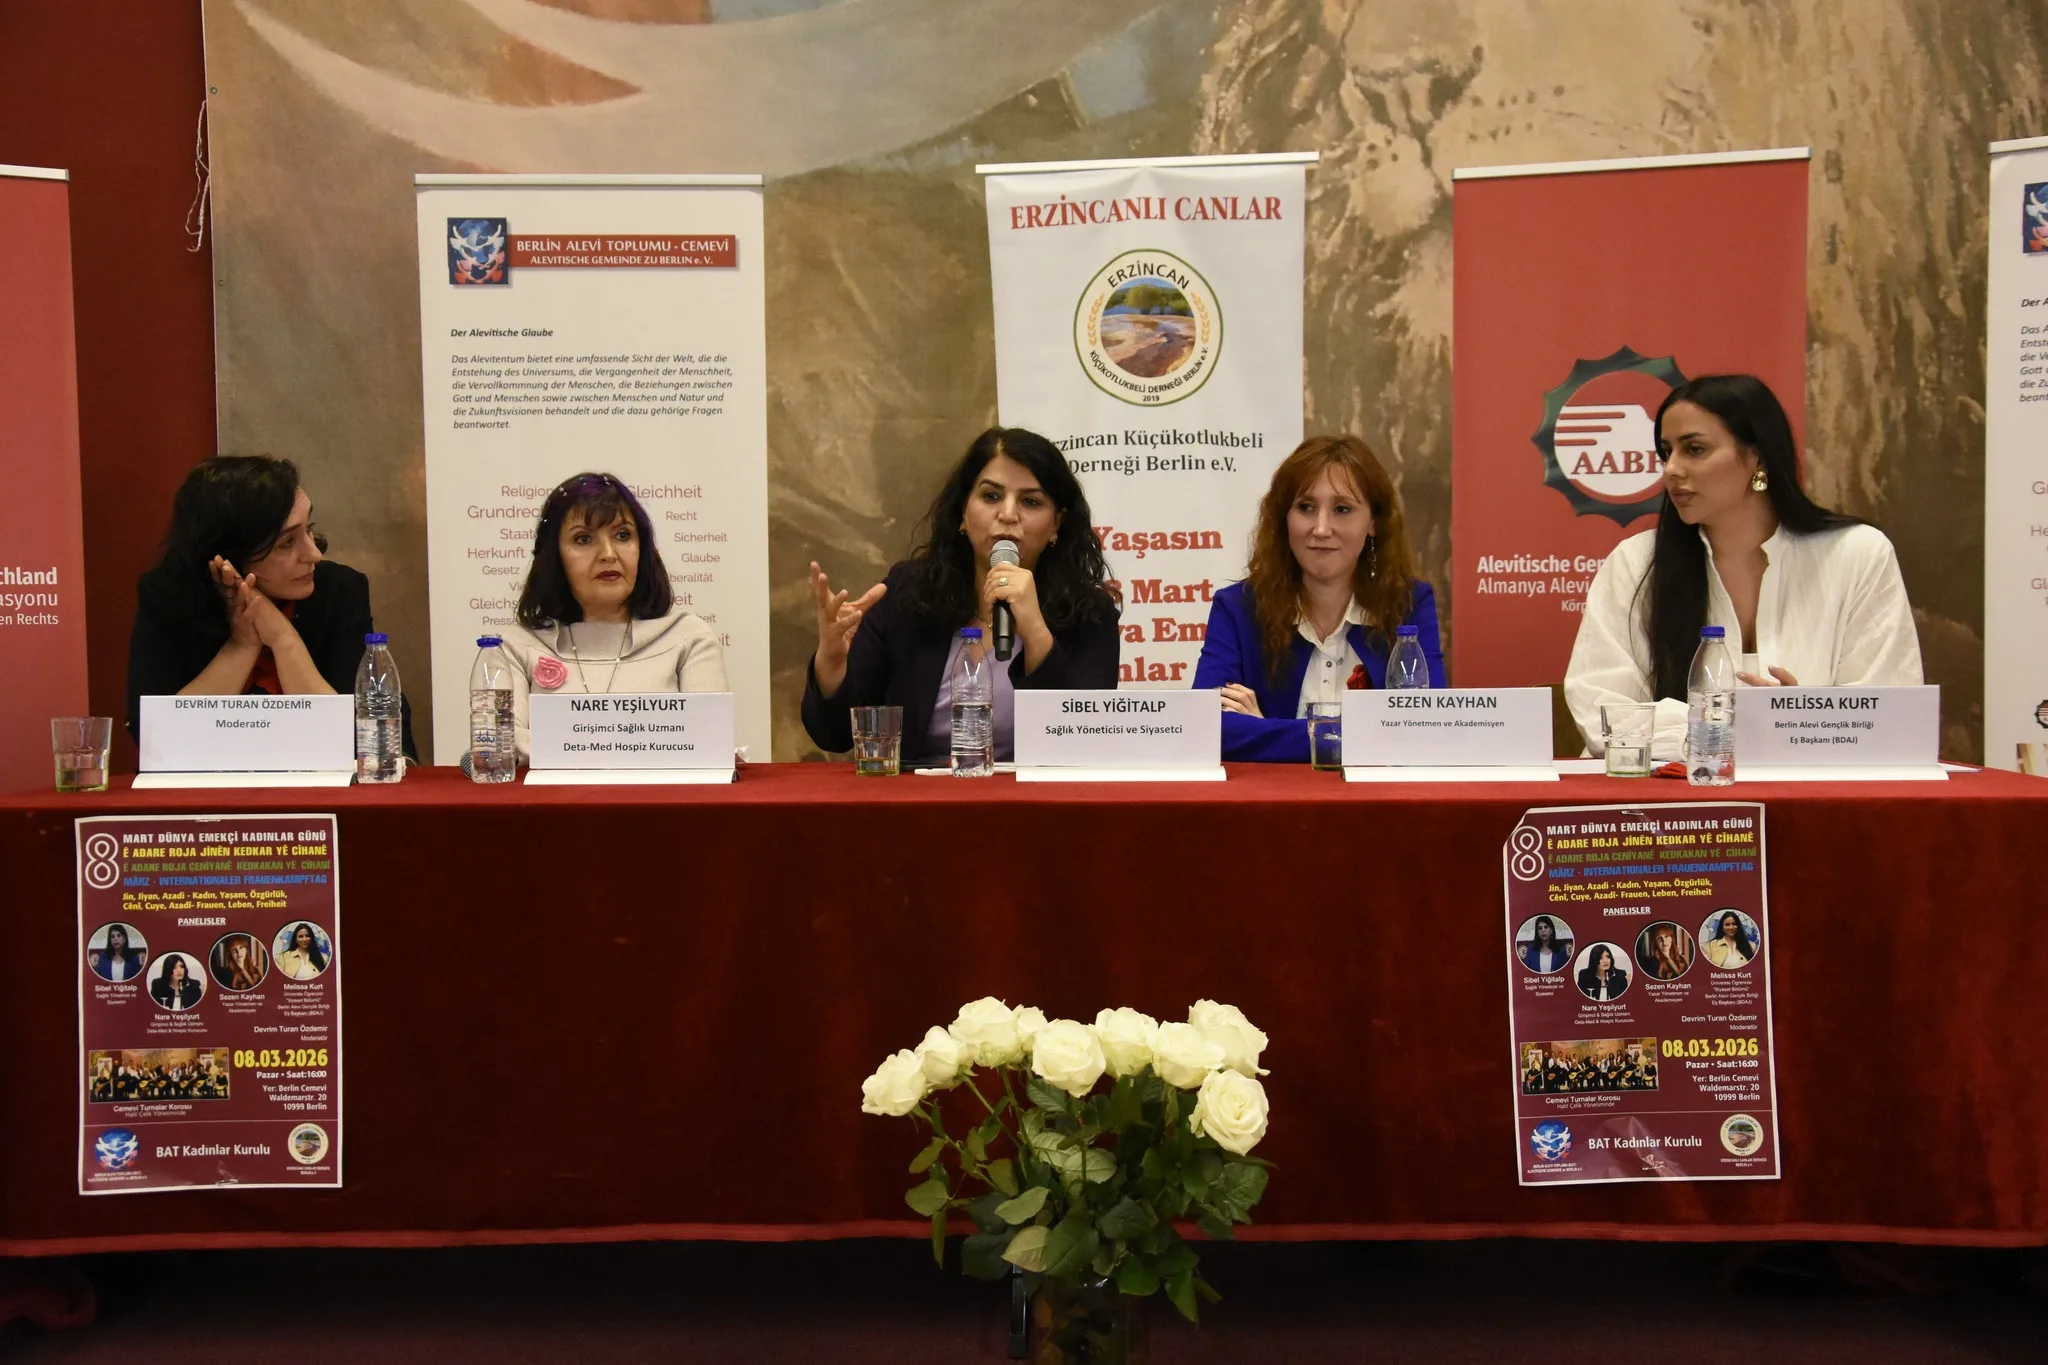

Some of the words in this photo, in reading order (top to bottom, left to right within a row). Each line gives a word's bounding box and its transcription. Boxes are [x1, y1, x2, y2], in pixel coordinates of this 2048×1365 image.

[1010, 194, 1166, 230] ERZİNCANLI
[1174, 196, 1282, 222] CANLAR
[517, 238, 561, 251] BERLİN
[566, 238, 601, 251] ALEVİ
[606, 240, 671, 251] TOPLUMU
[681, 238, 728, 251] CEMEVİ
[530, 256, 590, 264] ALEVITISCHE
[591, 256, 642, 264] GEMEINDE
[644, 256, 658, 264] ZU
[659, 256, 692, 264] BERLIN
[1107, 260, 1190, 291] ERZİNCAN
[2021, 298, 2041, 308] Der
[450, 329, 467, 337] Der
[469, 328, 519, 337] Alevitische
[521, 328, 553, 337] Glaube
[2020, 326, 2040, 335] Das
[451, 355, 468, 363] Das
[470, 354, 525, 363] Alevitentum
[527, 354, 553, 363] bietet
[576, 354, 630, 365] umfassende
[632, 354, 653, 363] Sicht
[655, 354, 670, 363] der
[673, 354, 695, 364] Welt,
[698, 354, 712, 363] die
[712, 354, 727, 363] die
[452, 368, 502, 378] Entstehung
[504, 368, 520, 376] des
[522, 368, 576, 377] Universums,
[578, 368, 593, 376] die
[595, 367, 660, 378] Vergangenheit
[662, 367, 677, 376] der
[679, 367, 732, 376] Menschheit,
[452, 381, 466, 390] die
[468, 380, 549, 391] Vervollkommnung
[550, 380, 566, 389] der
[568, 380, 616, 390] Menschen,
[618, 380, 632, 389] die
[634, 380, 691, 390] Beziehungen
[692, 380, 732, 389] zwischen
[1148, 376, 1183, 393] DERNEĞİ
[453, 420, 511, 429] beantwortet.
[1053, 434, 1118, 451] zincan
[1124, 429, 1264, 451] Küçükotlukbeli
[1068, 455, 1140, 476] Derneği
[1146, 454, 1206, 472] Berlin
[1211, 456, 1236, 472] e.V.
[467, 504, 542, 518] Grundrec
[665, 510, 697, 521] Recht
[674, 532, 728, 542] Sicherheit
[1092, 526, 1223, 559] Yaşasın
[467, 546, 525, 559] Herkunft
[681, 553, 720, 563] Glaube
[1476, 554, 1571, 574] Alevitische
[482, 565, 520, 575] Gesetz
[669, 572, 714, 583] beralität
[1131, 579, 1214, 604] Mart
[1477, 577, 1546, 598] Almanya
[1550, 576, 1590, 594] Alevi
[16, 612, 59, 625] Rechts
[1119, 656, 1188, 682] nlar
[175, 698, 218, 709] DEVRİM
[221, 700, 258, 709] TURAN
[262, 698, 312, 709] ÖZDEMİR
[571, 699, 609, 711] NARE
[613, 696, 686, 714] YEŞİLYURT
[1062, 698, 1099, 713] SİBEL
[1103, 696, 1166, 713] YİĞİTALP
[1388, 696, 1432, 708] SEZEN
[1436, 696, 1497, 708] KAYHAN
[1771, 694, 1834, 710] MELİSSA
[1839, 697, 1879, 710] KURT
[216, 719, 271, 728] Moderatör
[572, 723, 615, 734] Girişimci
[617, 723, 646, 734] Sağlık
[648, 723, 684, 732] Uzmanı
[1454, 720, 1504, 728] Akademisyen
[1820, 721, 1850, 730] Gençlik
[1851, 721, 1874, 730] Birliği
[1045, 724, 1074, 736] Sağlık
[1076, 725, 1123, 734] Yöneticisi
[1140, 724, 1182, 736] Siyasetci
[1790, 736, 1798, 745] Eş
[1800, 736, 1830, 745] Başkanı
[1832, 736, 1858, 745] (BDAJ)
[564, 742, 612, 751] Deta-Med
[615, 742, 646, 753] Hospiz
[649, 742, 694, 751] Kurucusu
[1556, 838, 1589, 849] ADARE
[1592, 837, 1619, 848] ROJA
[1622, 834, 1653, 846] JİNÊN
[1656, 835, 1696, 845] KEDKAR
[1716, 831, 1754, 843] CÎHANÊ
[1511, 826, 1545, 882] 8
[1546, 824, 1576, 835] MART
[1581, 822, 1616, 834] DÜNYA
[1620, 820, 1660, 834] EMEKÇİ
[1664, 820, 1718, 830] KADINLAR
[1723, 817, 1752, 829] GÜNÜ
[84, 832, 120, 889] 8
[123, 834, 154, 844] MART
[158, 832, 195, 843] DÜNYA
[198, 830, 238, 844] EMEKÇİ
[242, 832, 294, 842] KADINLAR
[298, 830, 326, 841] GÜNÜ
[178, 917, 226, 925] PANELISLER
[1662, 1038, 1758, 1058] 08.03.2026
[234, 1048, 328, 1068] 08.03.2026
[1686, 1061, 1709, 1069] Pazar
[1716, 1060, 1758, 1068] Saat:16:00
[256, 1071, 279, 1079] Pazar
[286, 1070, 327, 1078] Saat:16:00
[278, 1084, 300, 1092] Berlin
[300, 1084, 327, 1092] Cemevi
[318, 1093, 327, 1101] 20
[306, 1102, 327, 1110] Berlin
[1588, 1138, 1610, 1149] BAT
[1614, 1136, 1661, 1148] Kadınlar
[1664, 1135, 1702, 1147] Kurulu
[156, 1146, 179, 1158] BAT
[183, 1144, 231, 1156] Kadınlar
[234, 1144, 270, 1155] Kurulu
